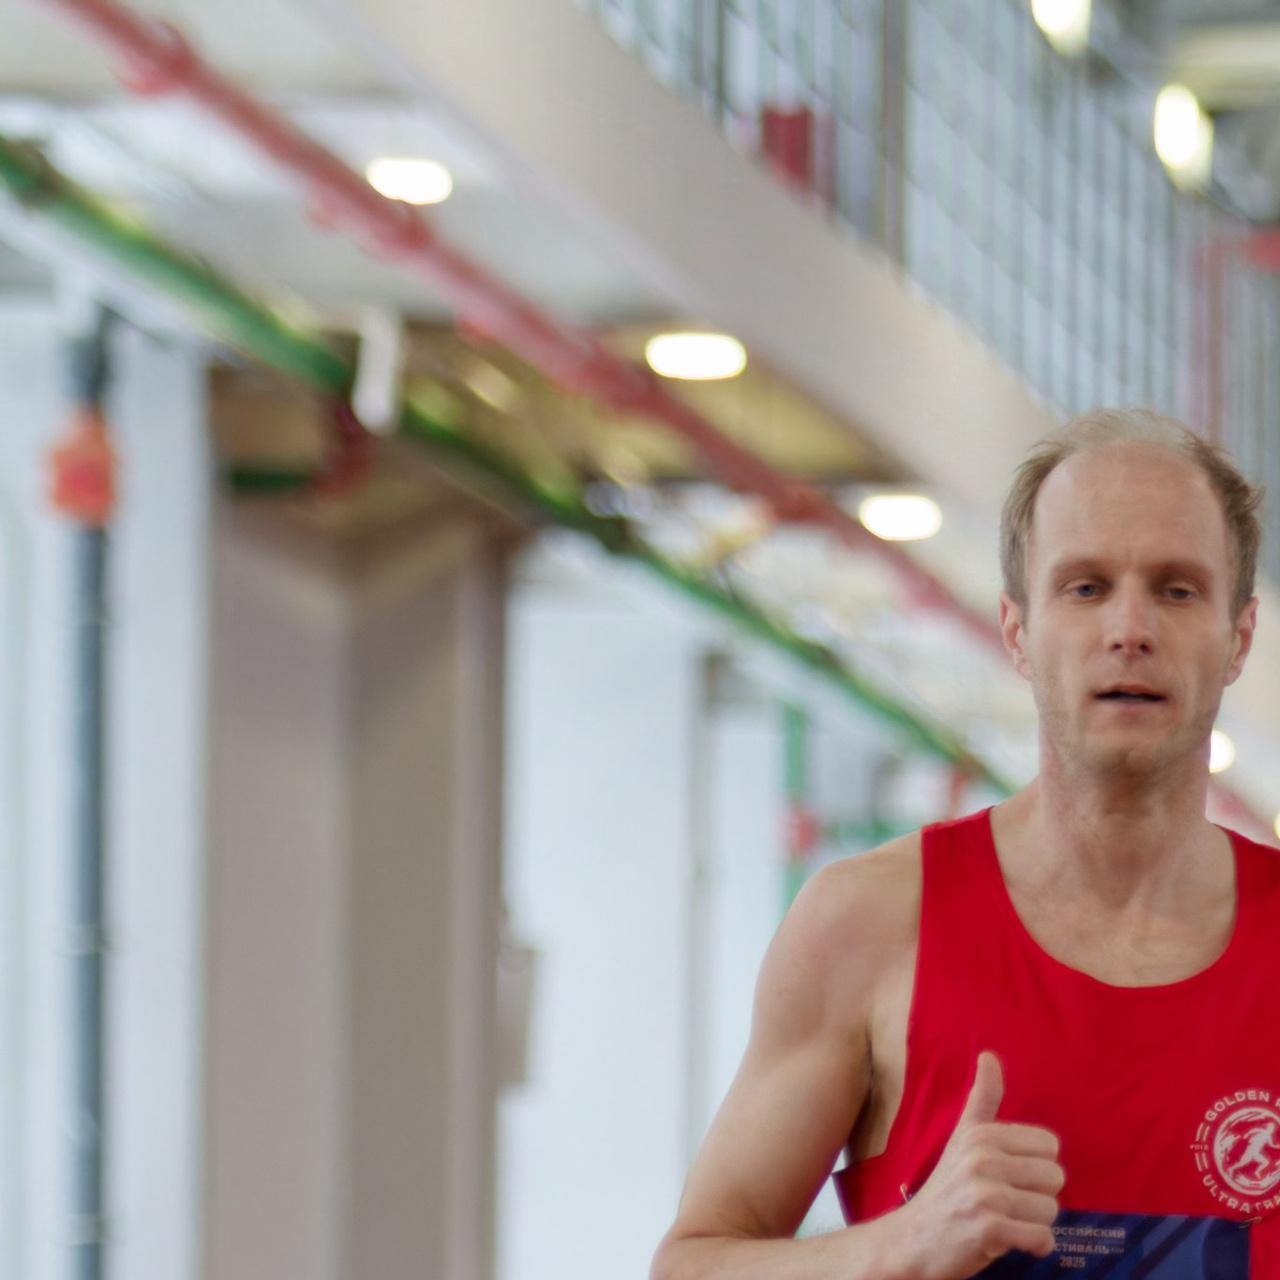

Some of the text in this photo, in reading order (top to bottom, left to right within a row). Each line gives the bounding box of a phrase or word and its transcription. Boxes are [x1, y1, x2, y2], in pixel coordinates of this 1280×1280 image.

[1204, 1089, 1270, 1122] GOLDEN
[1202, 1173, 1251, 1214] ULTRA
[1052, 1226, 1126, 1239] ОССИЙСКИЙ
